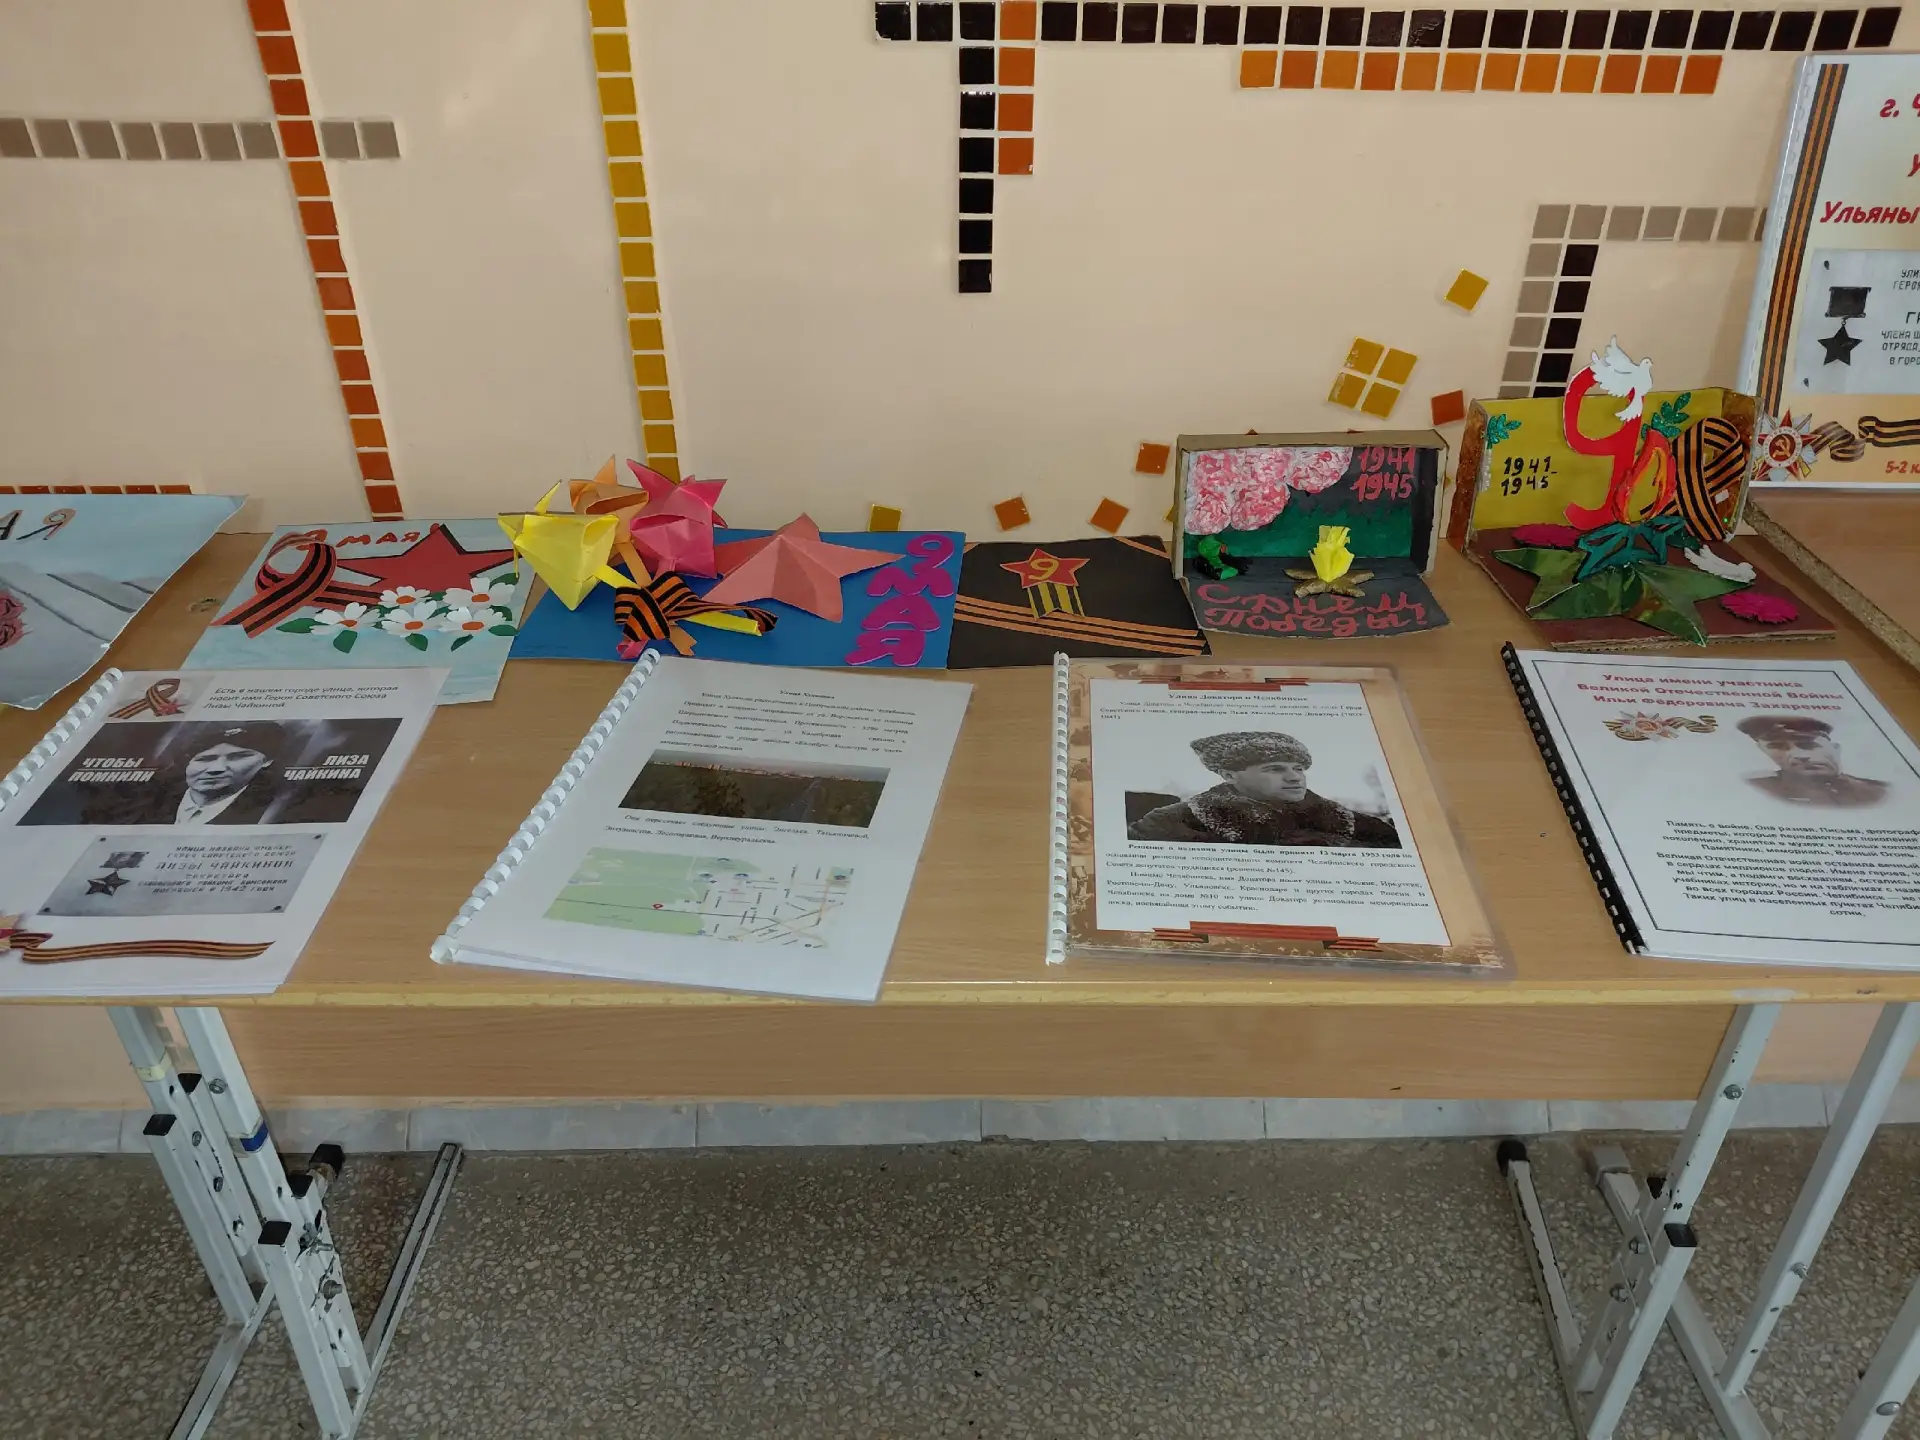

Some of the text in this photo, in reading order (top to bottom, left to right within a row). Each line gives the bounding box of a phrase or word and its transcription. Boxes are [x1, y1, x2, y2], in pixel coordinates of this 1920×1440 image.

[1820, 201, 1920, 224] Ульяны
[1881, 330, 1911, 340] ЧЛЕНА
[1358, 445, 1417, 474] 1941
[1885, 460, 1909, 474] 5-2
[1351, 473, 1413, 501] 1945
[1500, 475, 1549, 497] 1945
[906, 533, 955, 574] 9
[1028, 557, 1060, 582] 9
[1602, 674, 1654, 684] Улица
[1717, 680, 1803, 688] участника
[1577, 683, 1844, 700] Великой Отечественной Войны
[1593, 695, 1637, 703] Ильи
[1749, 701, 1842, 711] Захаренко
[82, 757, 143, 769] ЧТОБЫ
[323, 754, 370, 767] ЛИЗА
[68, 770, 155, 782] ПОМНИЛИ
[283, 767, 362, 781] ЧАЙКИНА
